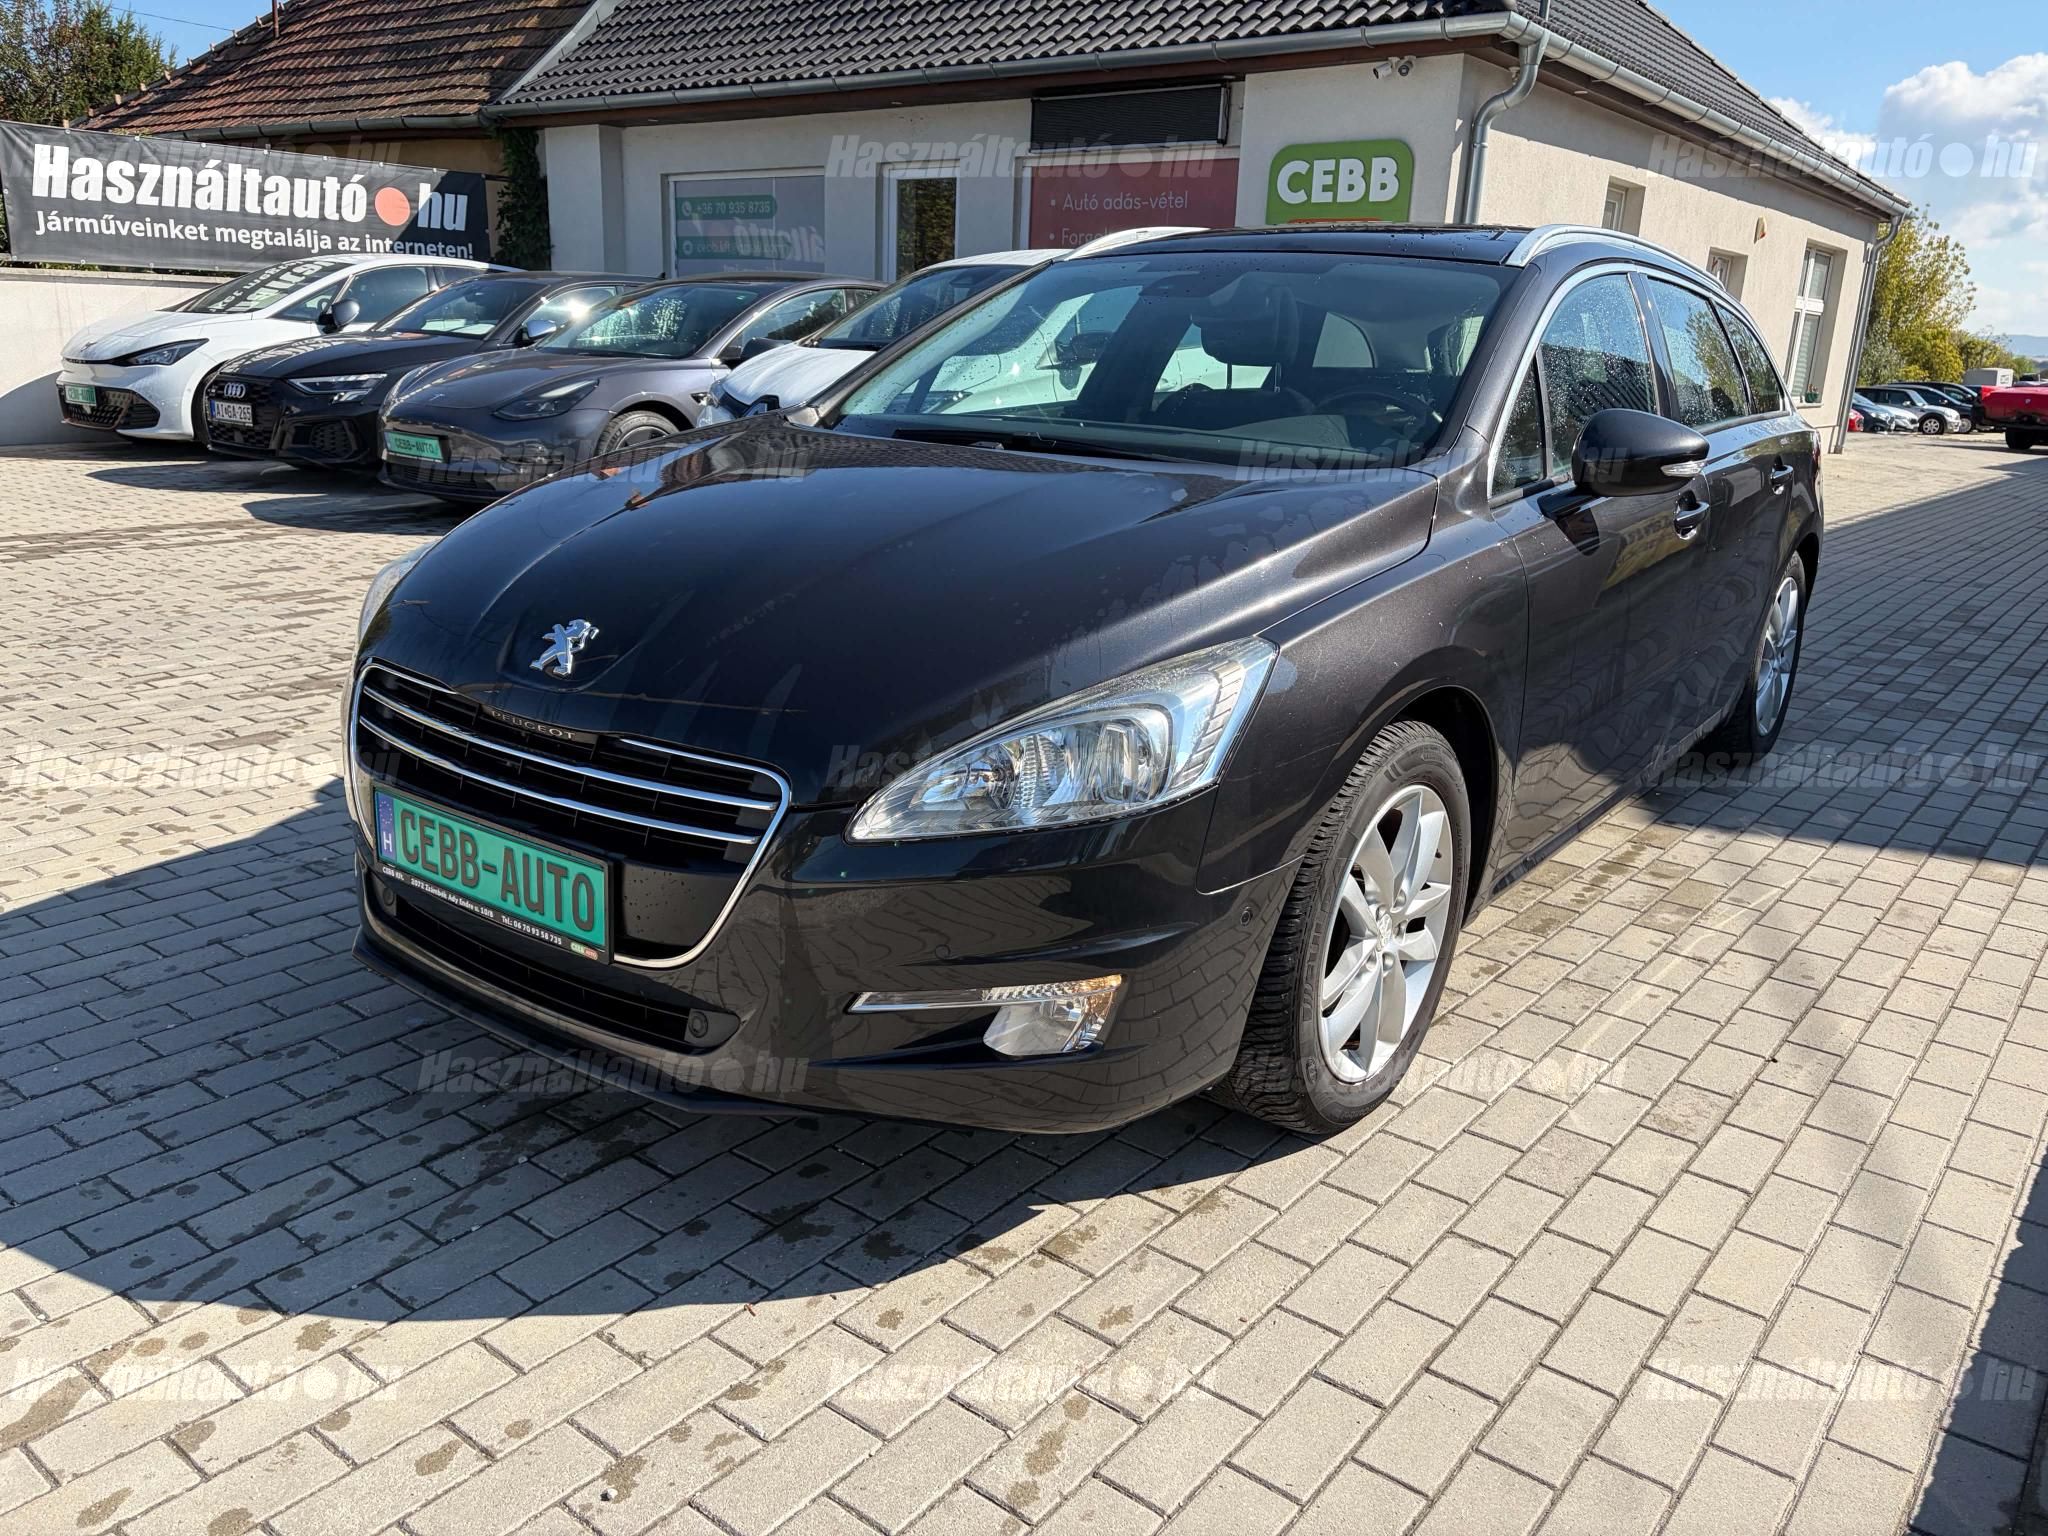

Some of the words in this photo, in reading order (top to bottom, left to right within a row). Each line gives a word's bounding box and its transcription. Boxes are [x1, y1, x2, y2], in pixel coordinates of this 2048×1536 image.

[1276, 157, 1399, 204] CEBB
[716, 202, 726, 214] 70
[1062, 192, 1098, 211] Autó
[1103, 191, 1188, 210] adás-vétel
[35, 211, 209, 241] Járműveinket
[215, 225, 332, 254] megtalálja
[337, 238, 360, 251] az
[365, 234, 473, 259] interneten!
[394, 437, 437, 454] CEBB-AUTO
[491, 710, 576, 739] PEUGEOT
[383, 831, 393, 853] H
[401, 808, 596, 932] CEBB-AUTO
[513, 920, 522, 929] 06
[522, 924, 531, 933] 70
